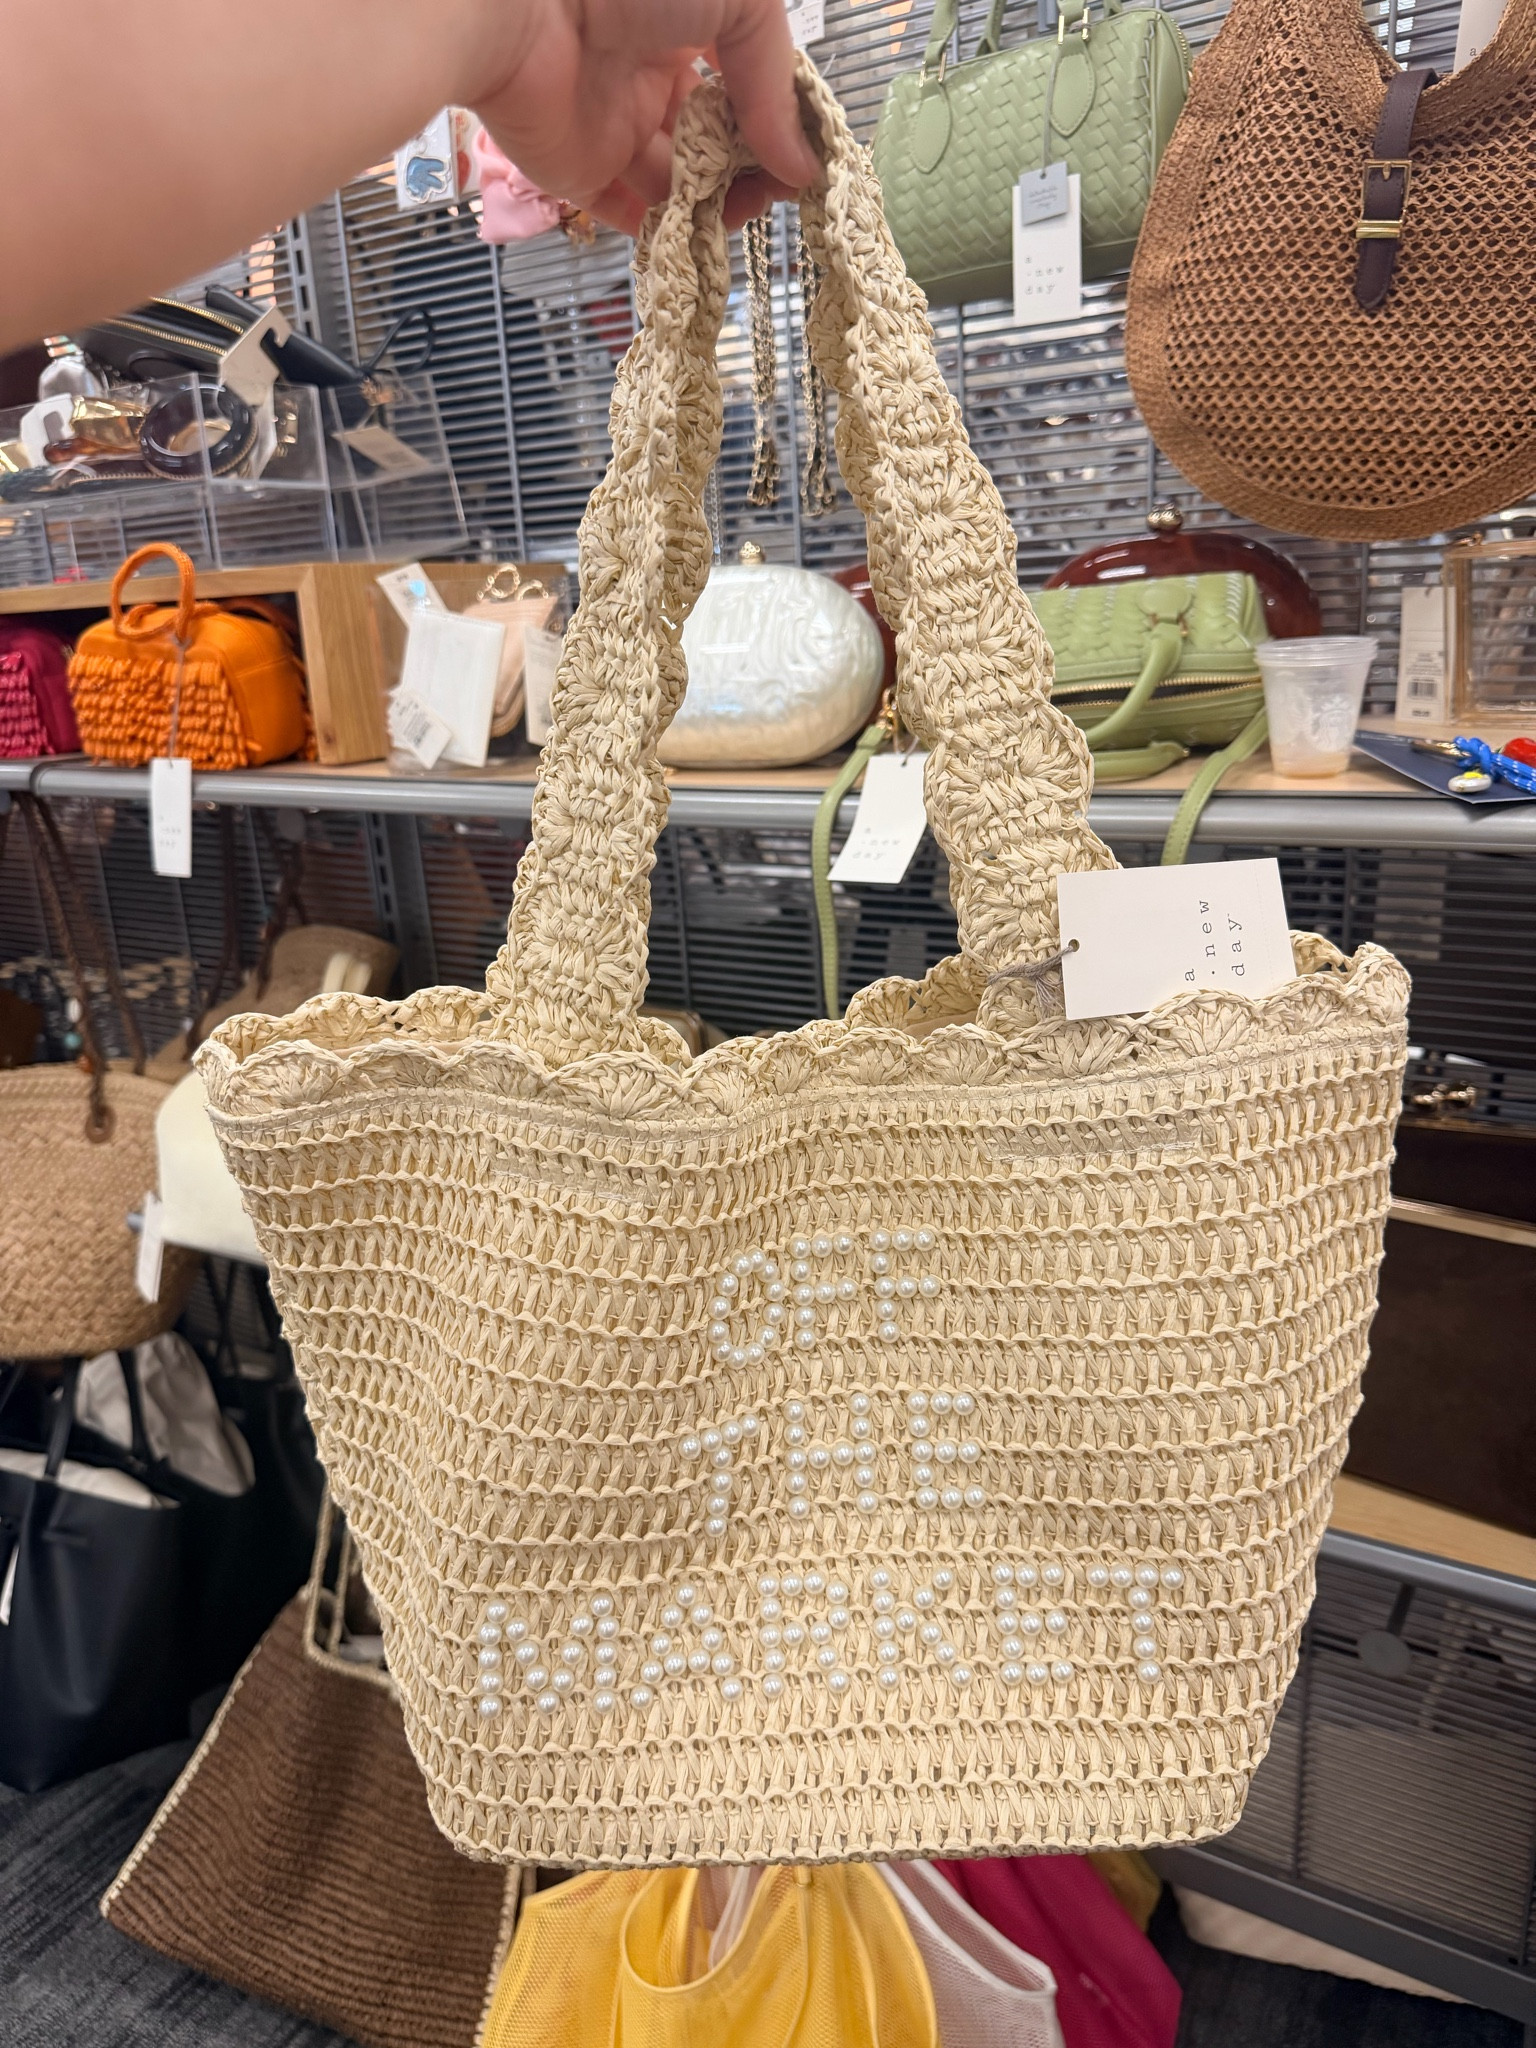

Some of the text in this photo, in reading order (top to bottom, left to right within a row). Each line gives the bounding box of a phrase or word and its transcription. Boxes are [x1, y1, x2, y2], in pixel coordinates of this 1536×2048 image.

[1184, 968, 1196, 982] a
[707, 1228, 942, 1370] OFF
[678, 1392, 987, 1537] THE
[477, 1564, 1184, 1719] MARKET
